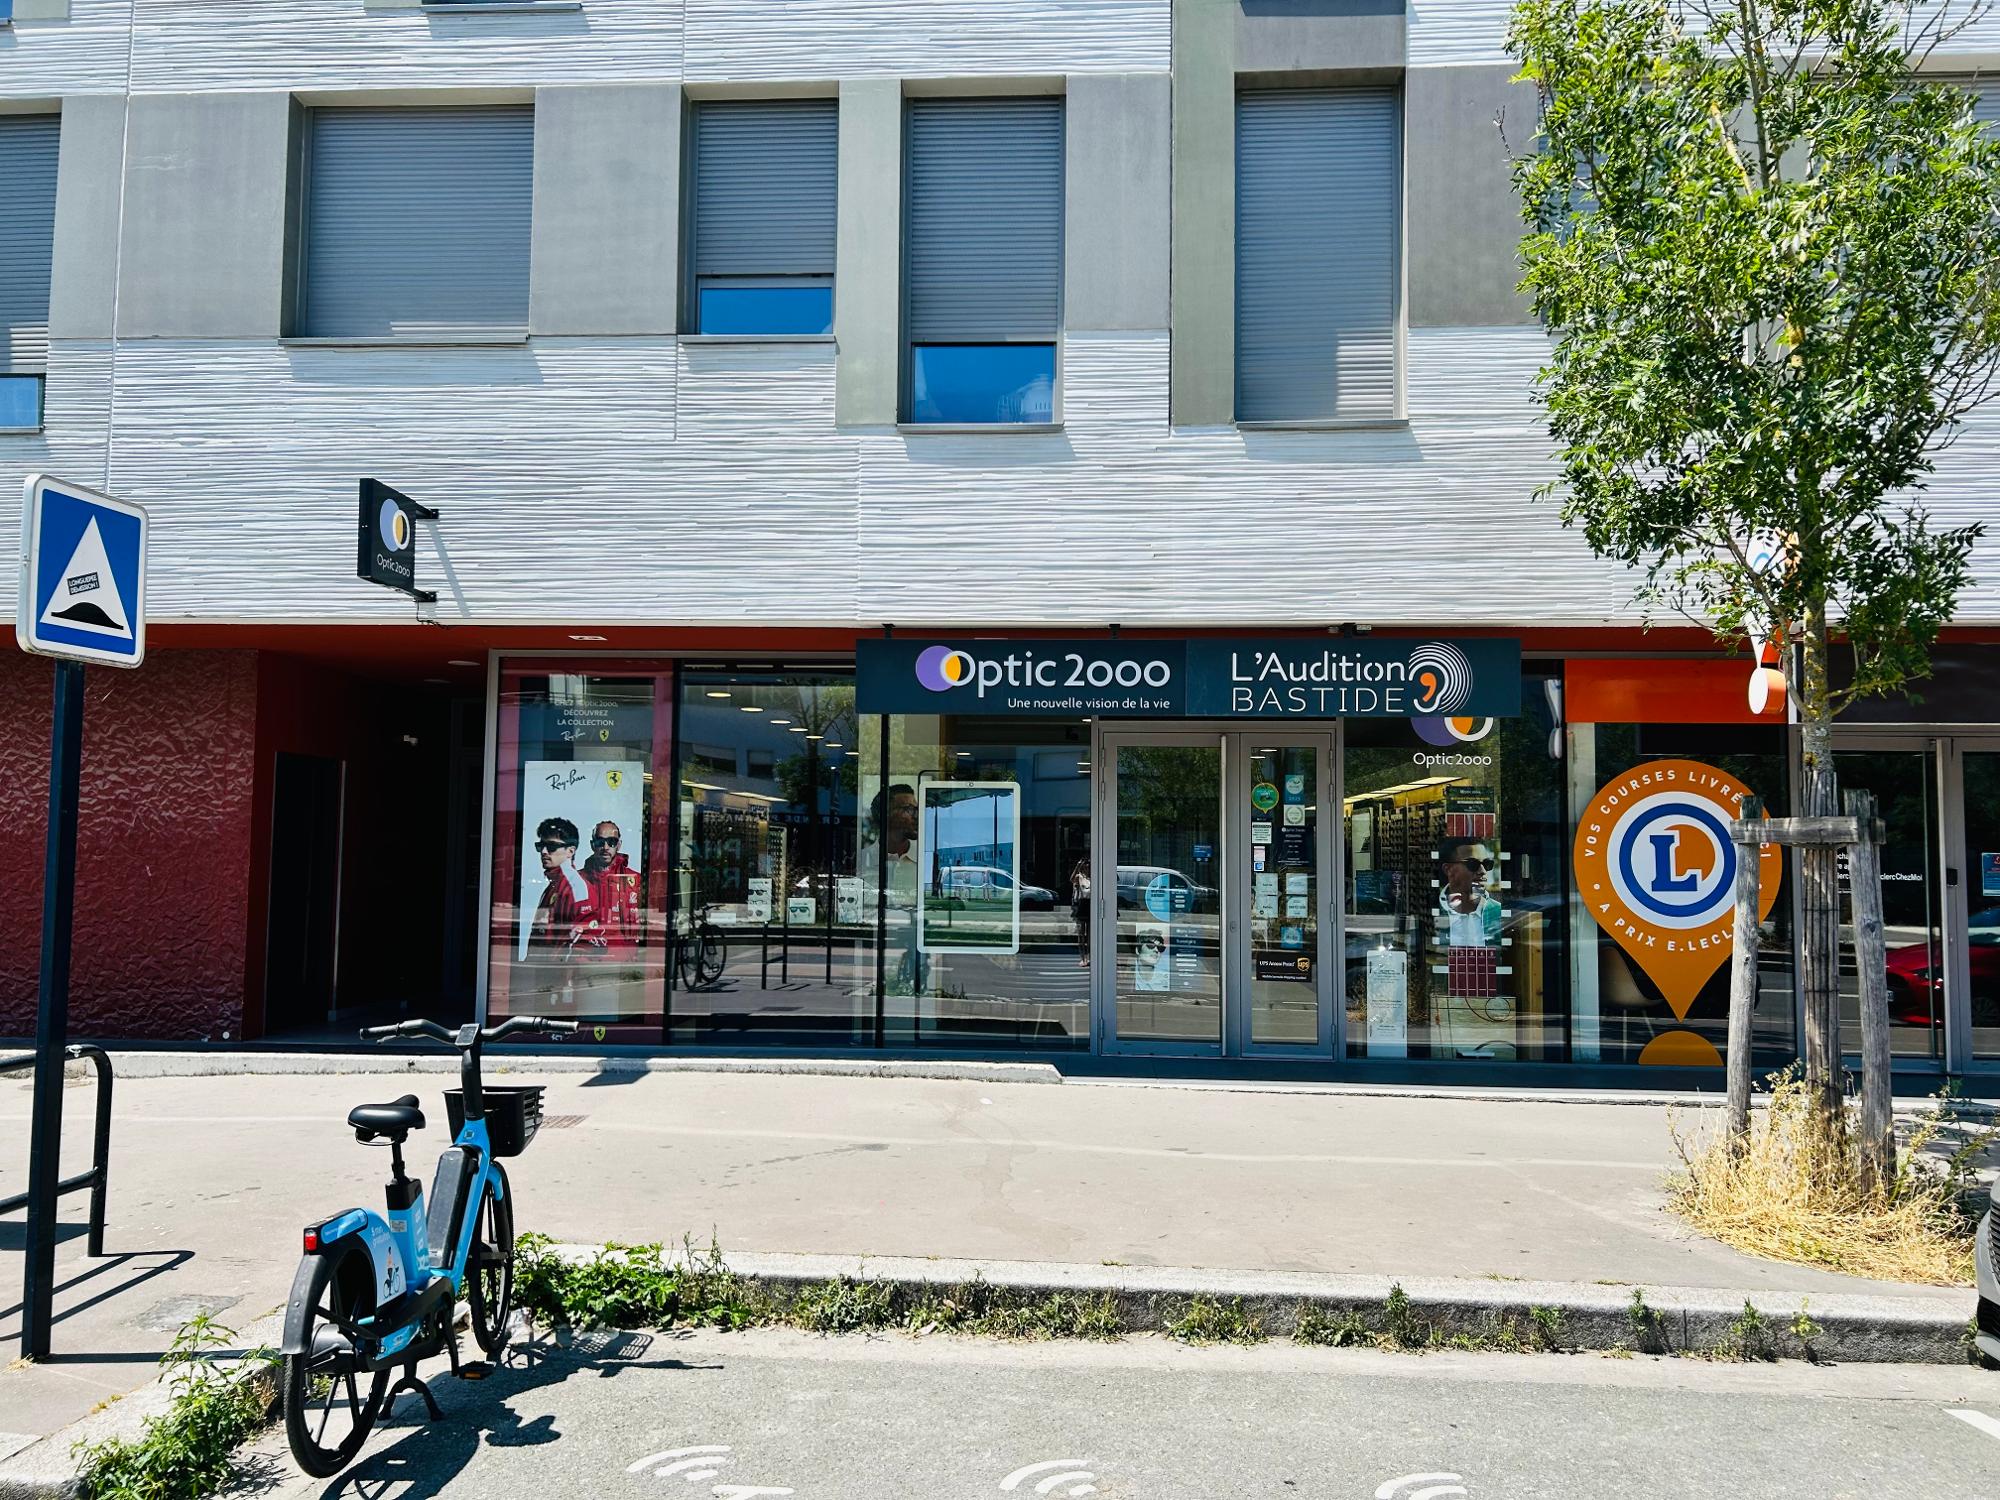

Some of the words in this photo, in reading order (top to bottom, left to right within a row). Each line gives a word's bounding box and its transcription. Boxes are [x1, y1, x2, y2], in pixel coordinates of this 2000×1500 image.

[377, 553, 395, 571] Optic
[940, 650, 1057, 698] Optic
[1064, 653, 1171, 687] 2000
[1231, 650, 1406, 682] L'Audition
[563, 708, 608, 717] DÉCOUVREZ
[1008, 698, 1031, 709] Une
[1033, 698, 1083, 709] nouvelle
[1085, 698, 1119, 709] vision
[1122, 698, 1136, 709] de
[1139, 698, 1150, 709] la
[1153, 699, 1171, 709] vie
[1232, 687, 1405, 713] BASTIDE
[1413, 752, 1453, 768] Optic
[1455, 753, 1492, 766] 2000
[1585, 823, 1601, 857] VOS
[1600, 769, 1676, 815] COURSES
[1688, 771, 1744, 804] LIVRÉ
[1649, 834, 1698, 892] L
[1879, 872, 1924, 881] clercChezMoi
[1614, 917, 1657, 947] PRIX
[1667, 929, 1734, 952] E.LECL
